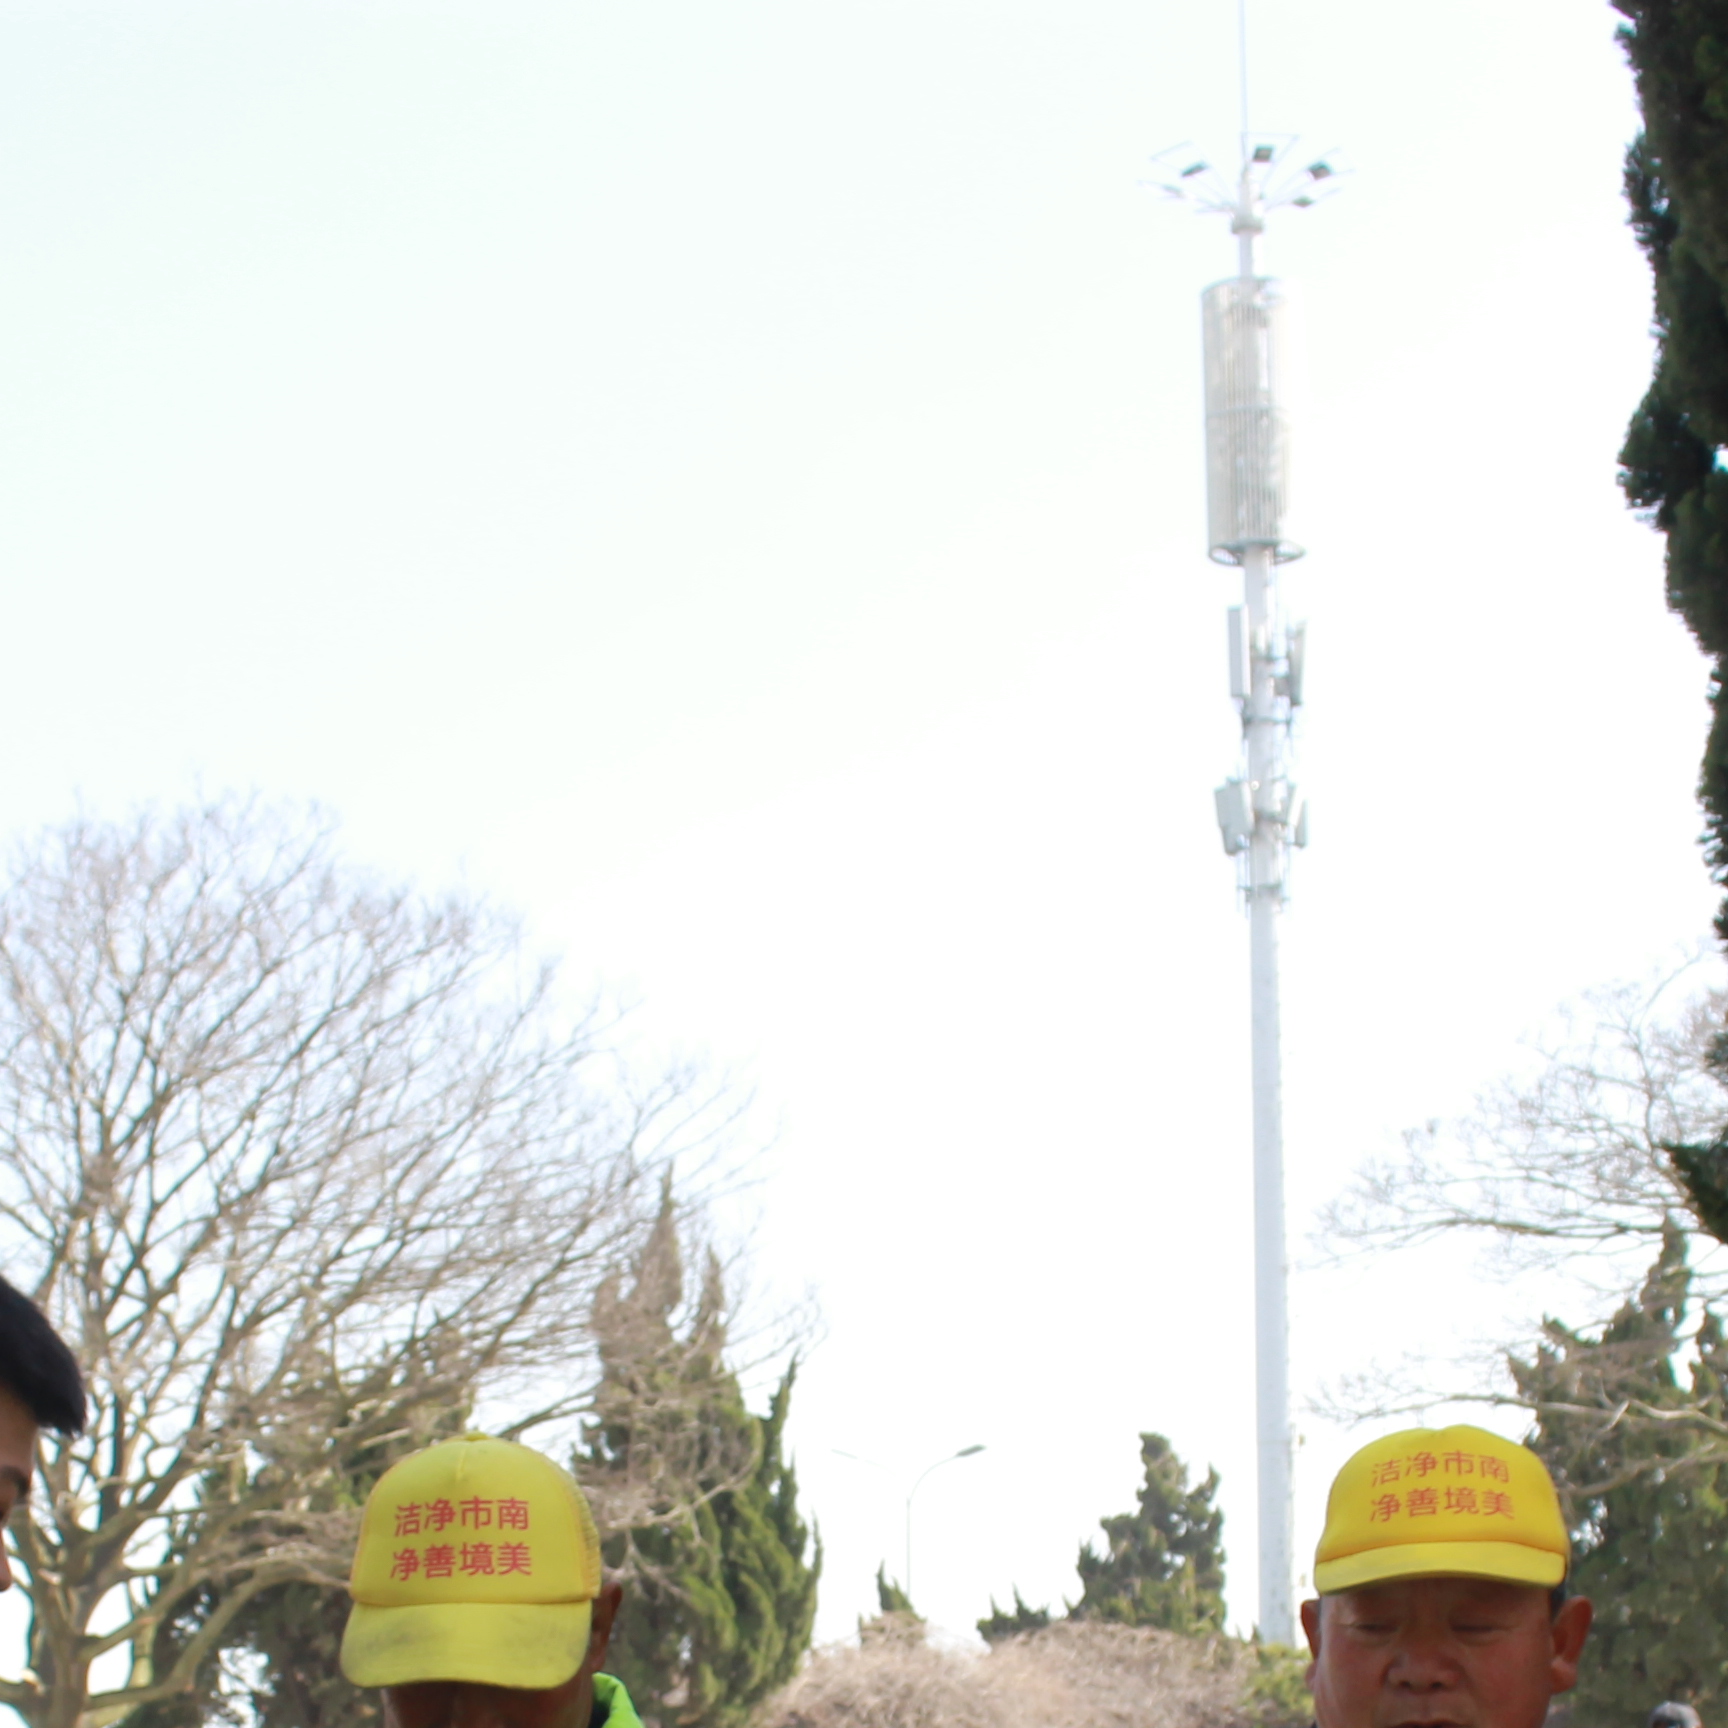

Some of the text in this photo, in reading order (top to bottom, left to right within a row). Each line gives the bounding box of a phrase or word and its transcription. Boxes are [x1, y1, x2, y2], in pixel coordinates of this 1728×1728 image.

[1371, 1450, 1510, 1487] 洁净市南
[394, 1496, 529, 1537] 洁净市南
[1369, 1486, 1515, 1522] 净善境美
[390, 1542, 532, 1581] 净善境美
